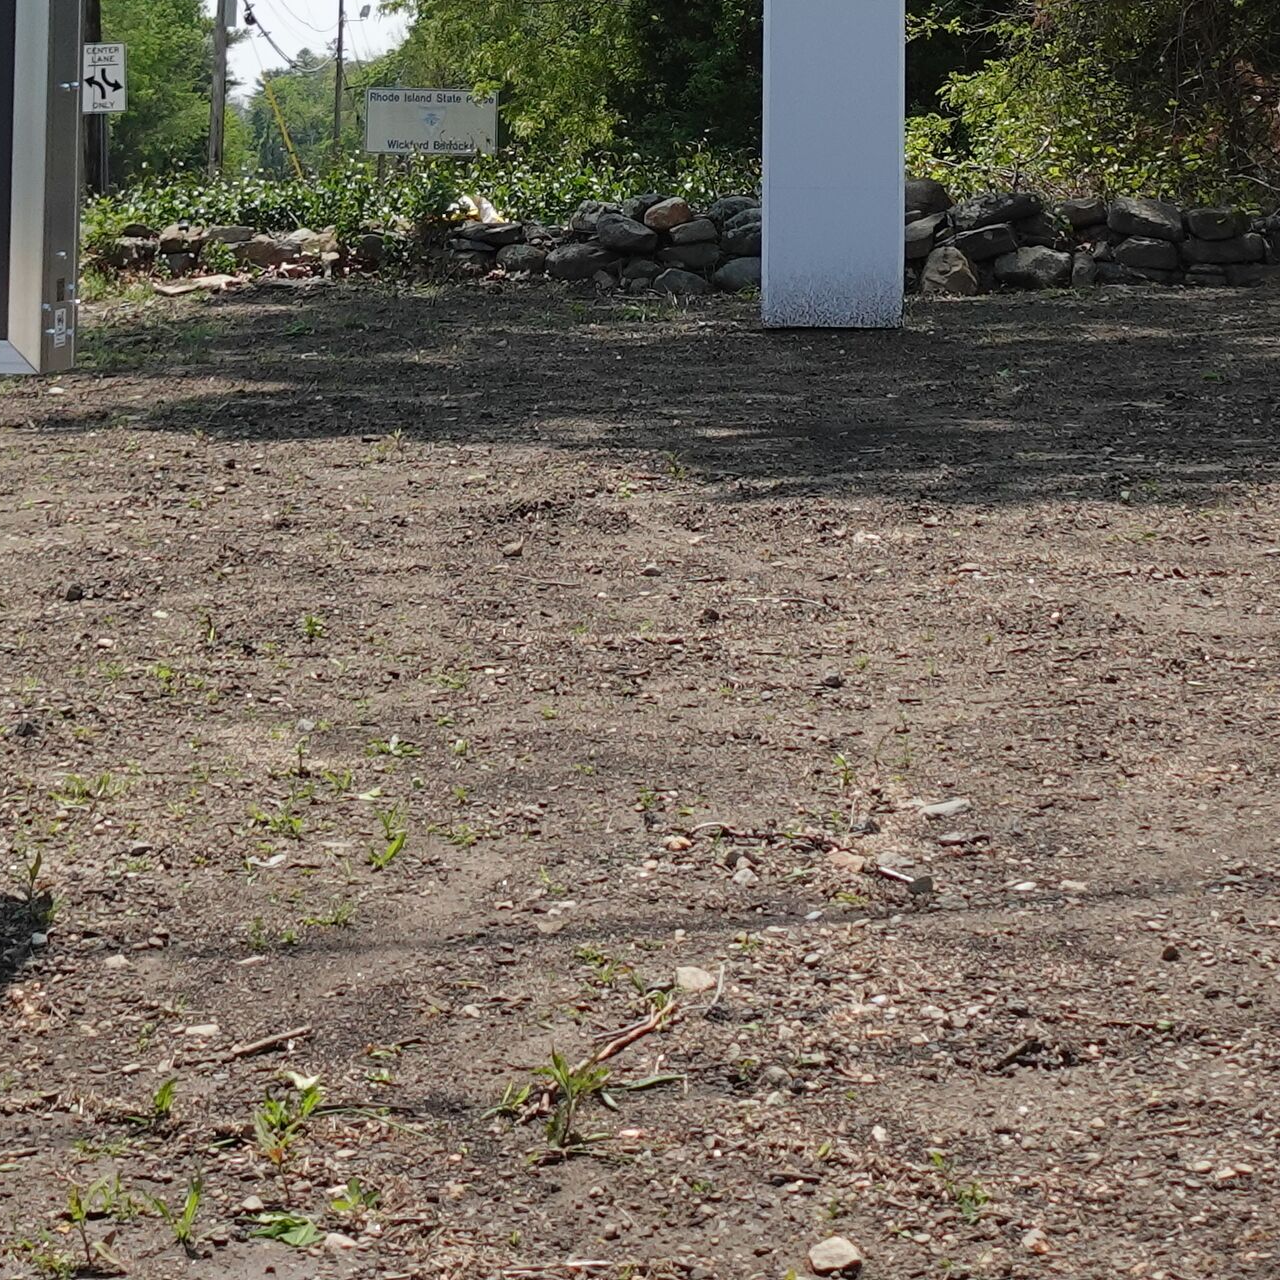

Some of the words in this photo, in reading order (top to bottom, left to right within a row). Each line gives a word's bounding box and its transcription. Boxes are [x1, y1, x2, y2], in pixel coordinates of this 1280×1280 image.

[370, 92, 400, 102] Rhode
[404, 92, 432, 103] Island
[436, 93, 462, 103] State
[92, 101, 115, 109] ONLY
